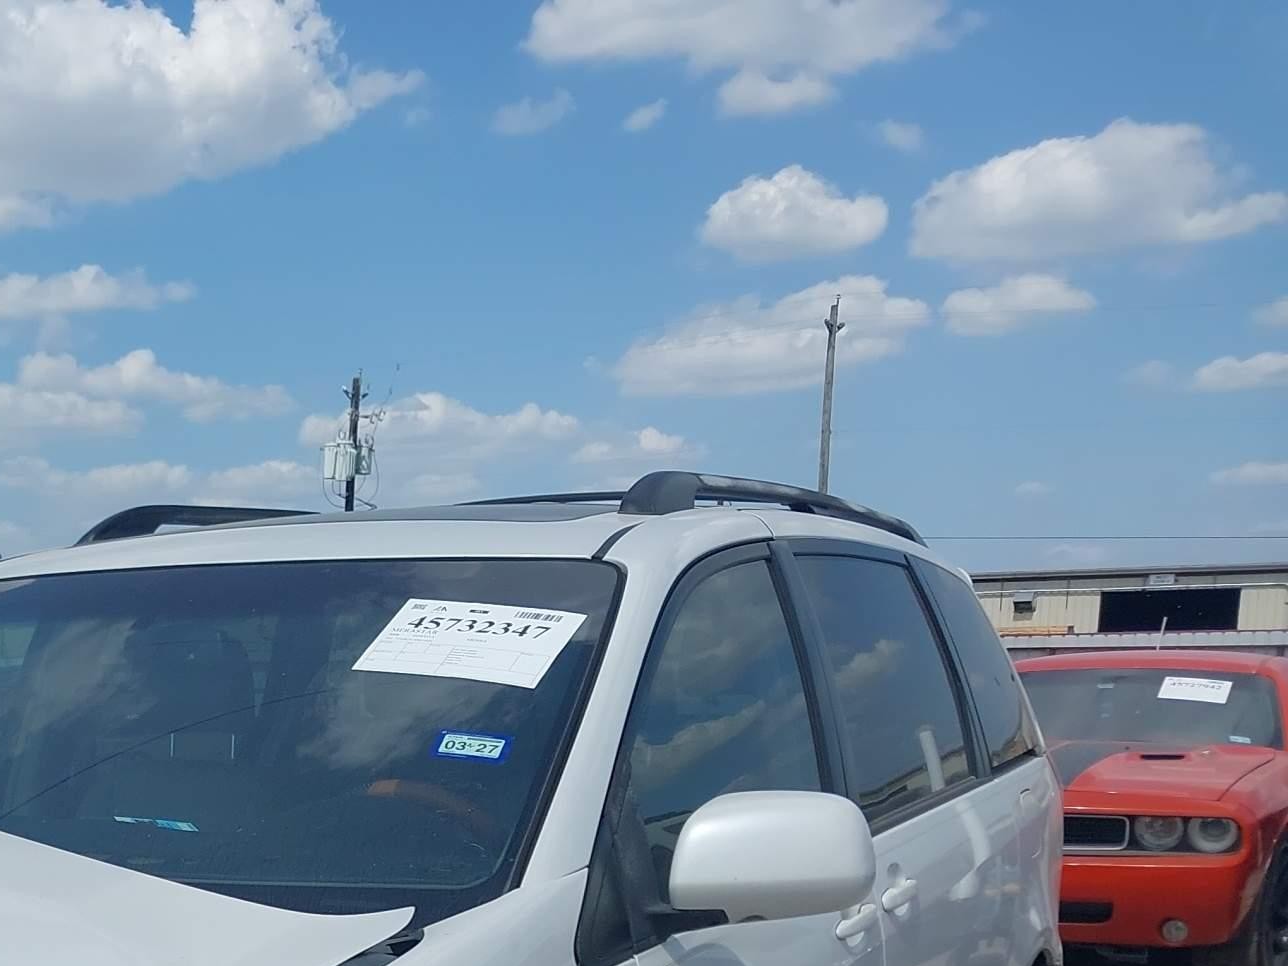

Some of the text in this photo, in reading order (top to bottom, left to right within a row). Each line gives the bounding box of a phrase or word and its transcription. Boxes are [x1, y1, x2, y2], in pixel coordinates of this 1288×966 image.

[407, 615, 552, 639] 45732347
[444, 740, 500, 754] 03 27
